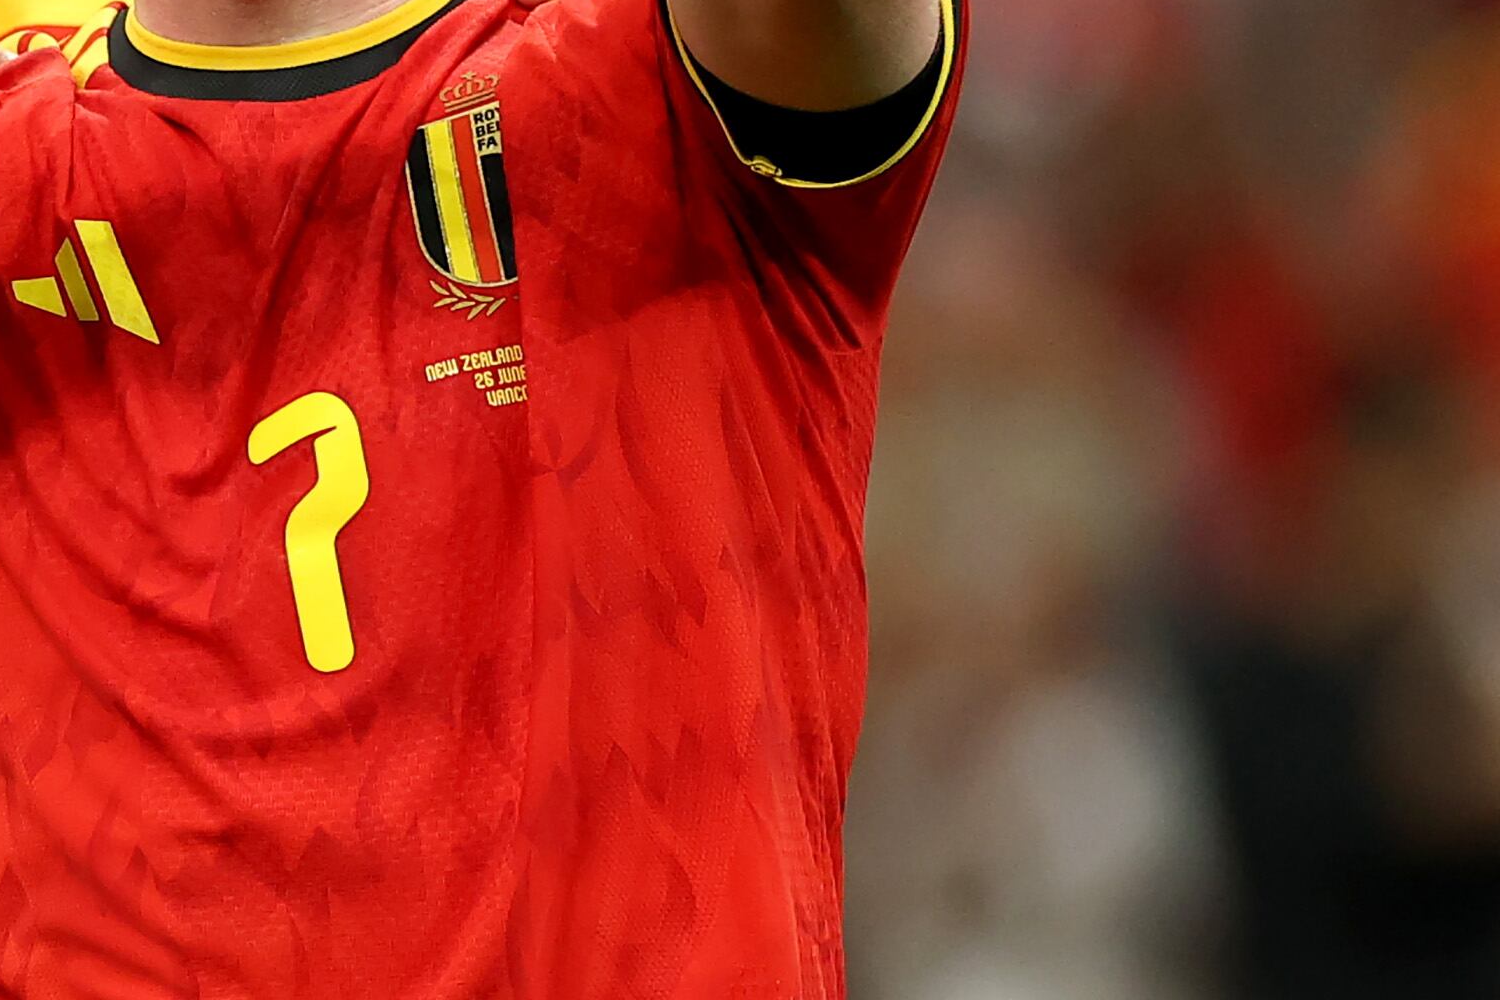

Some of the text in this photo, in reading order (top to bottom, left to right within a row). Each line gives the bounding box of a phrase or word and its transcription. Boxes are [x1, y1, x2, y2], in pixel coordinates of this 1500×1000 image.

[477, 136, 498, 151] FA
[425, 345, 523, 382] NEW ZEALAND
[474, 370, 495, 389] 26
[248, 391, 369, 673] 7
